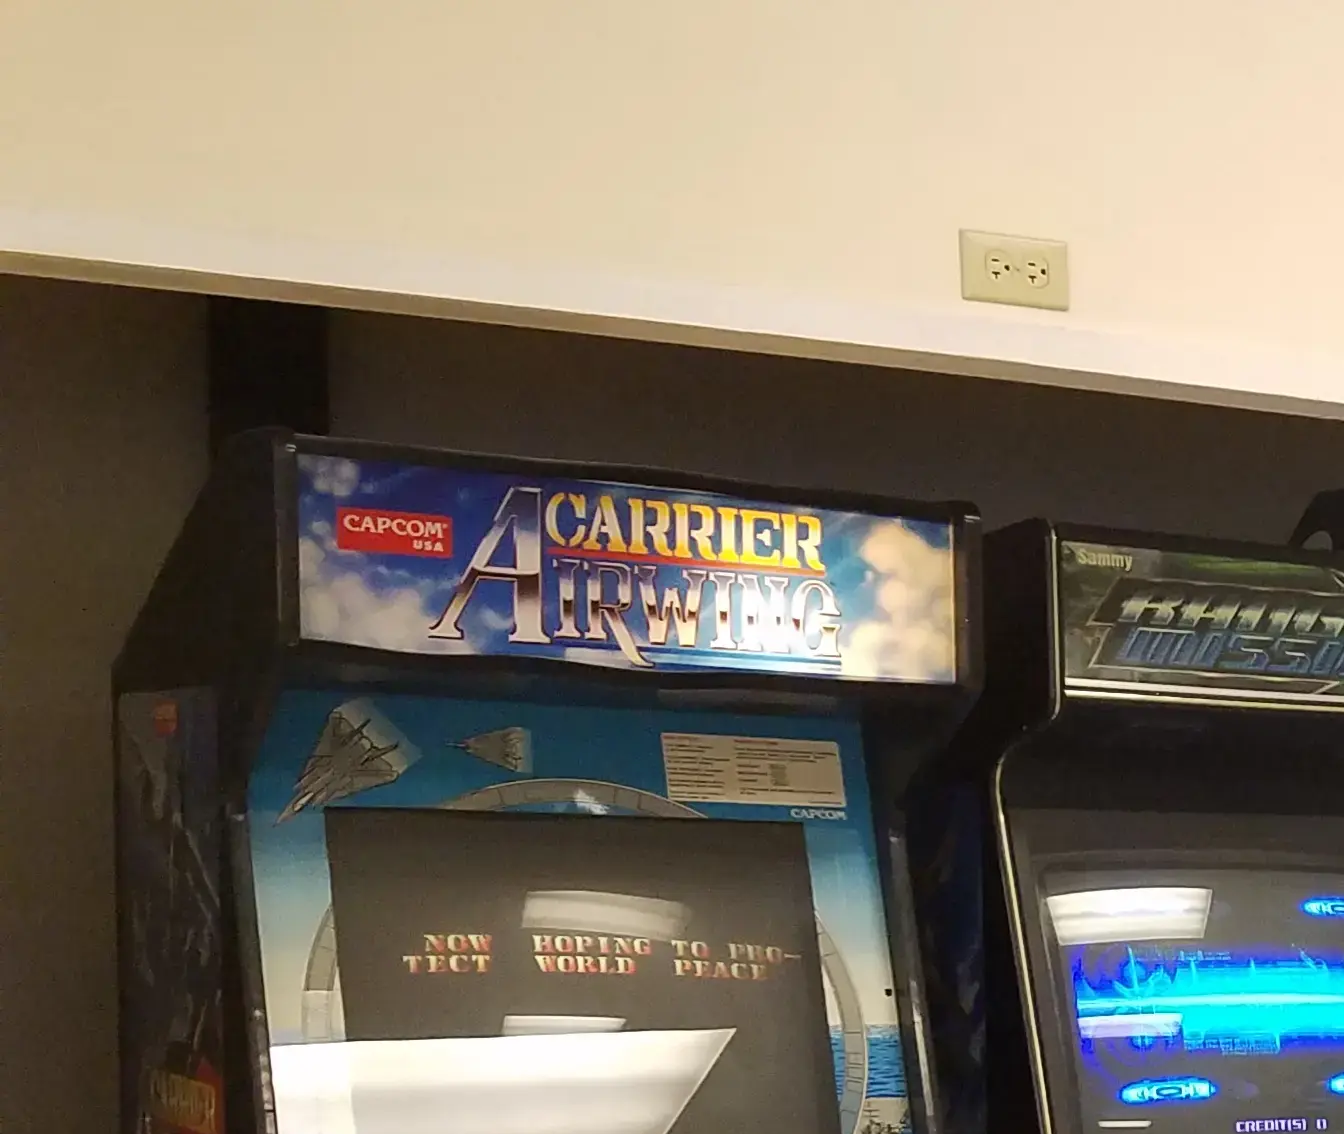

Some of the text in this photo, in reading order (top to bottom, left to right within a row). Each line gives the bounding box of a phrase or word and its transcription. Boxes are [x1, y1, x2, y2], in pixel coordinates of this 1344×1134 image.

[343, 514, 444, 539] CAPCOM
[545, 492, 826, 571] CARRIER
[413, 540, 444, 552] USA
[1078, 548, 1133, 571] Sammy
[427, 487, 842, 667] AIRWING
[790, 808, 848, 820] CAPCOM
[423, 933, 493, 954] NOW
[532, 934, 653, 956] HOPING
[671, 938, 710, 958] TO
[402, 955, 769, 981] TECT WORLD PEACE
[1235, 1117, 1308, 1133] CREDIT(S)
